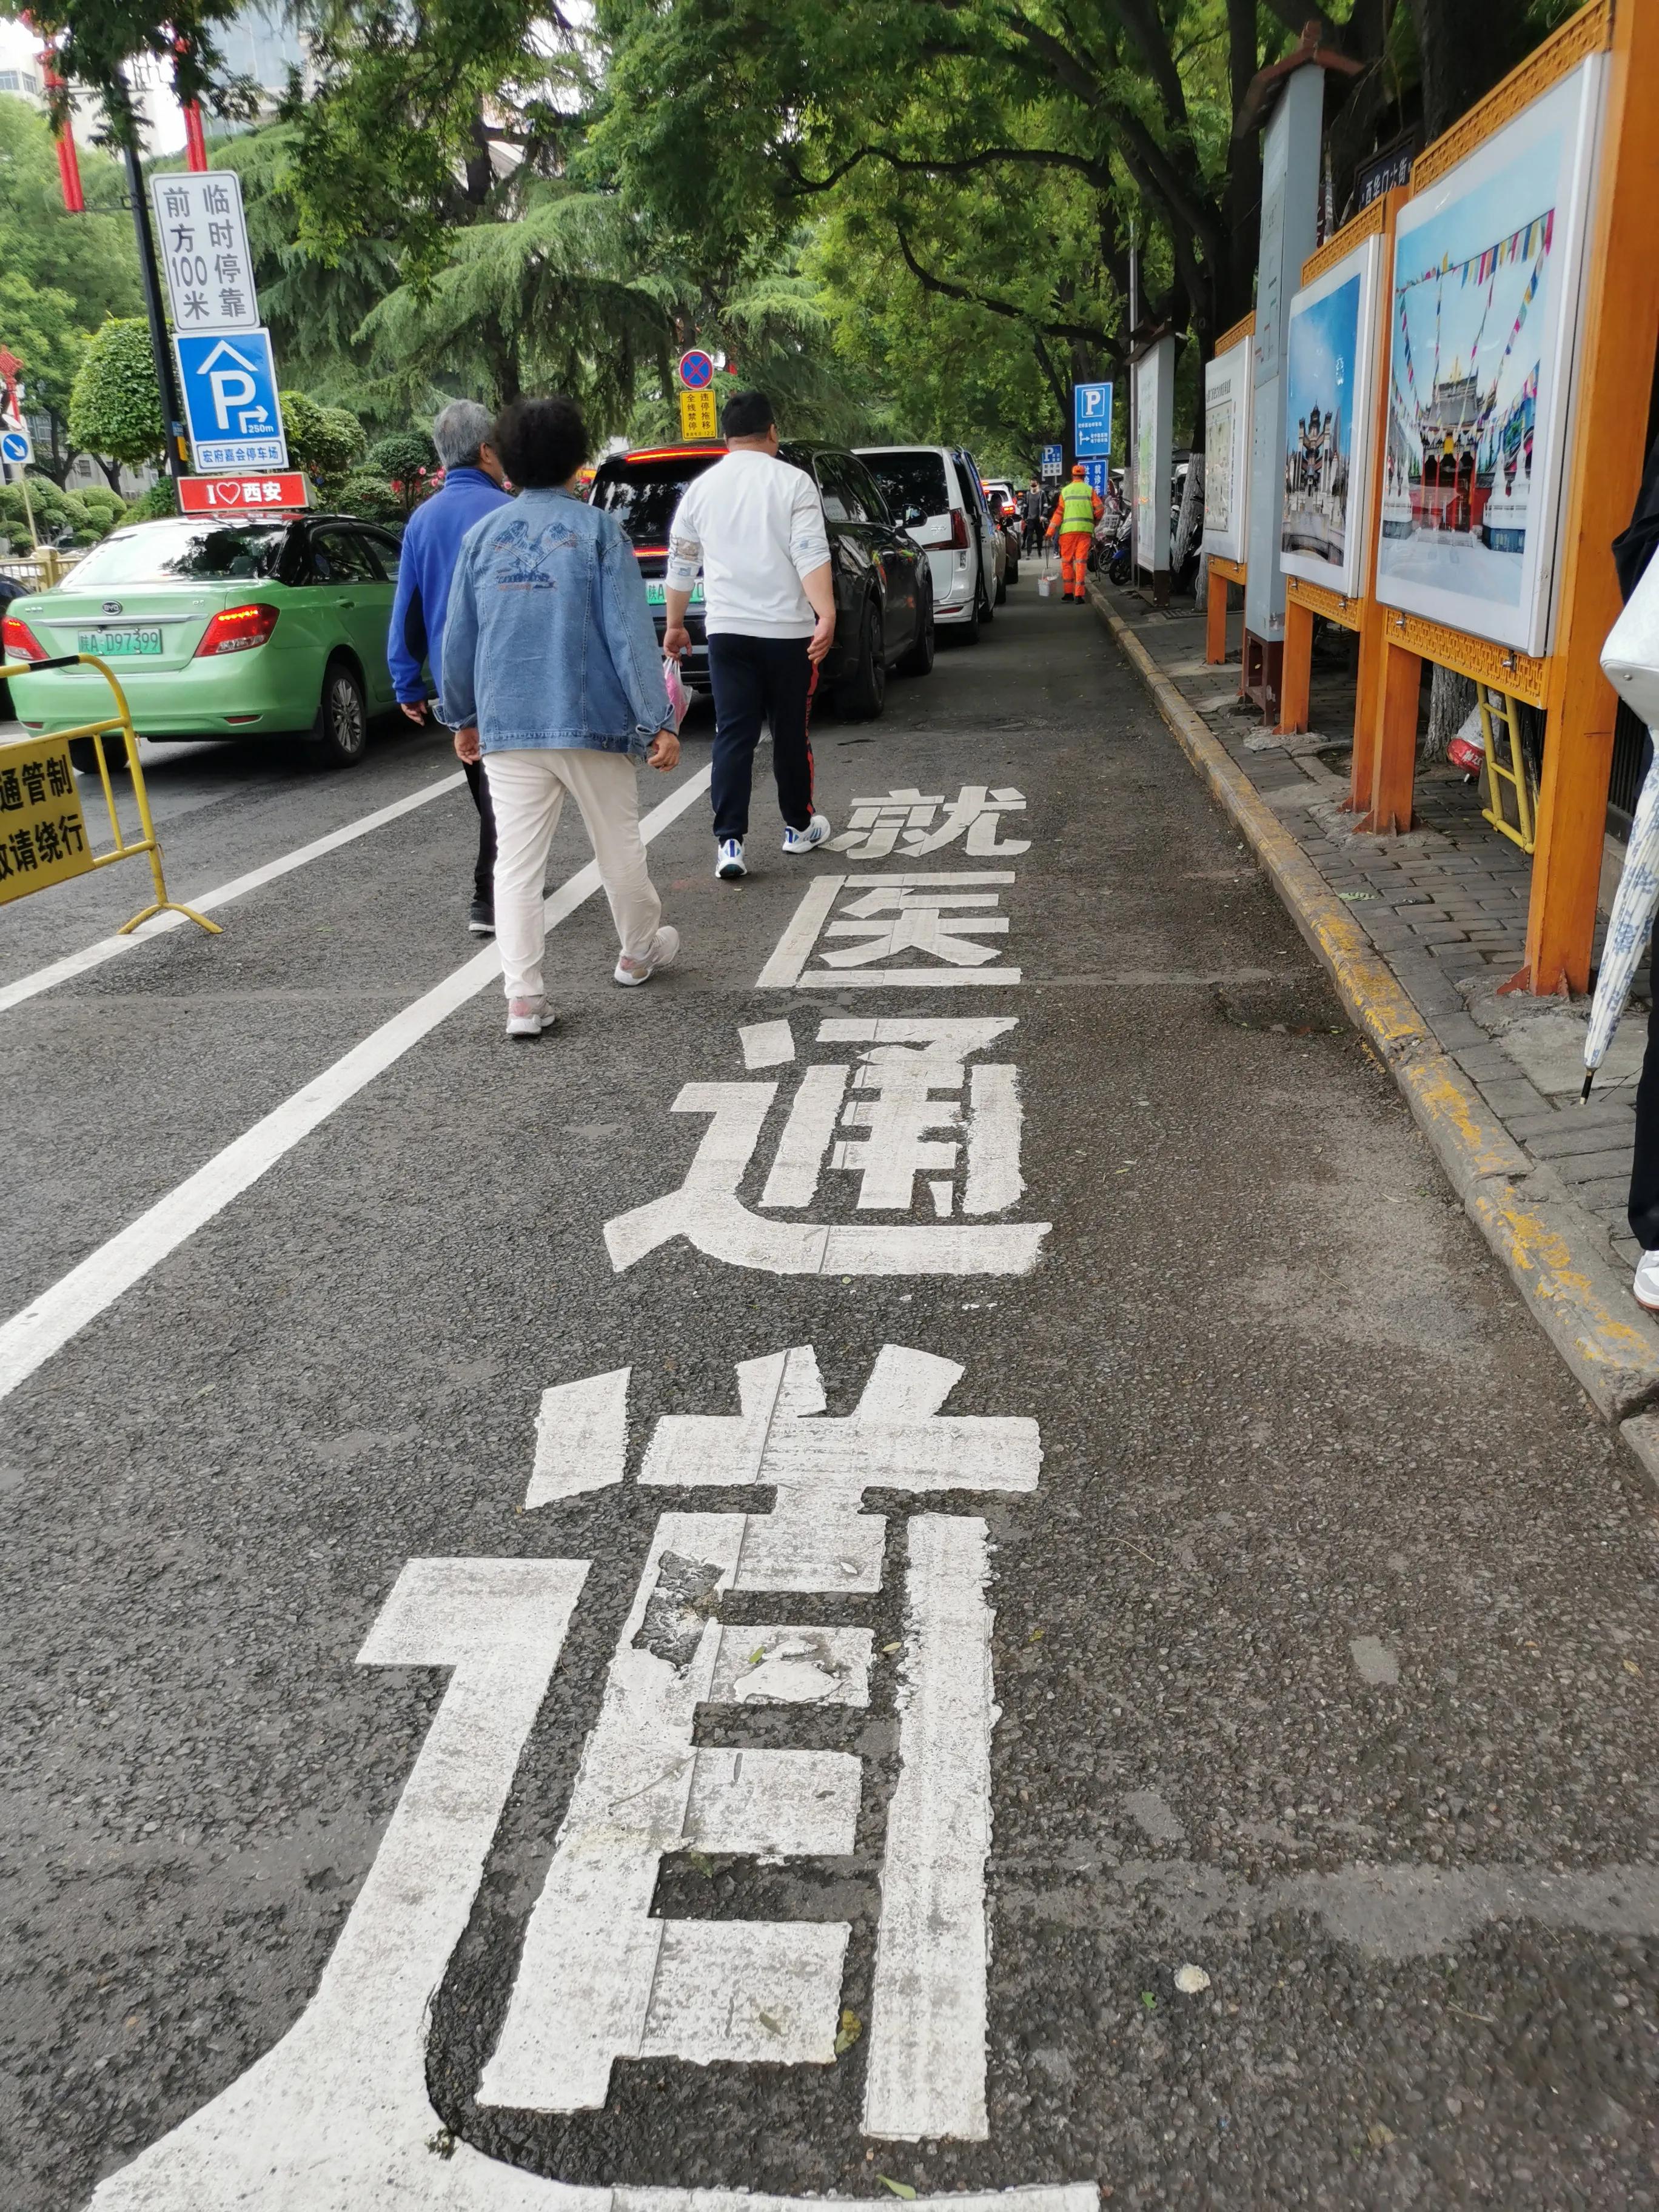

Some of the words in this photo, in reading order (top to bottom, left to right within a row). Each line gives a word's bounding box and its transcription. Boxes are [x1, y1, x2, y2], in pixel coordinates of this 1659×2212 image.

[203, 184, 246, 317] 临时停靠
[210, 370, 256, 430] P
[686, 394, 697, 431] 全线禁停
[700, 392, 711, 430] 违停拖移
[1085, 391, 1101, 415] P
[247, 424, 274, 434] 250m
[243, 481, 282, 503] 西安
[0, 754, 73, 813] 通管制
